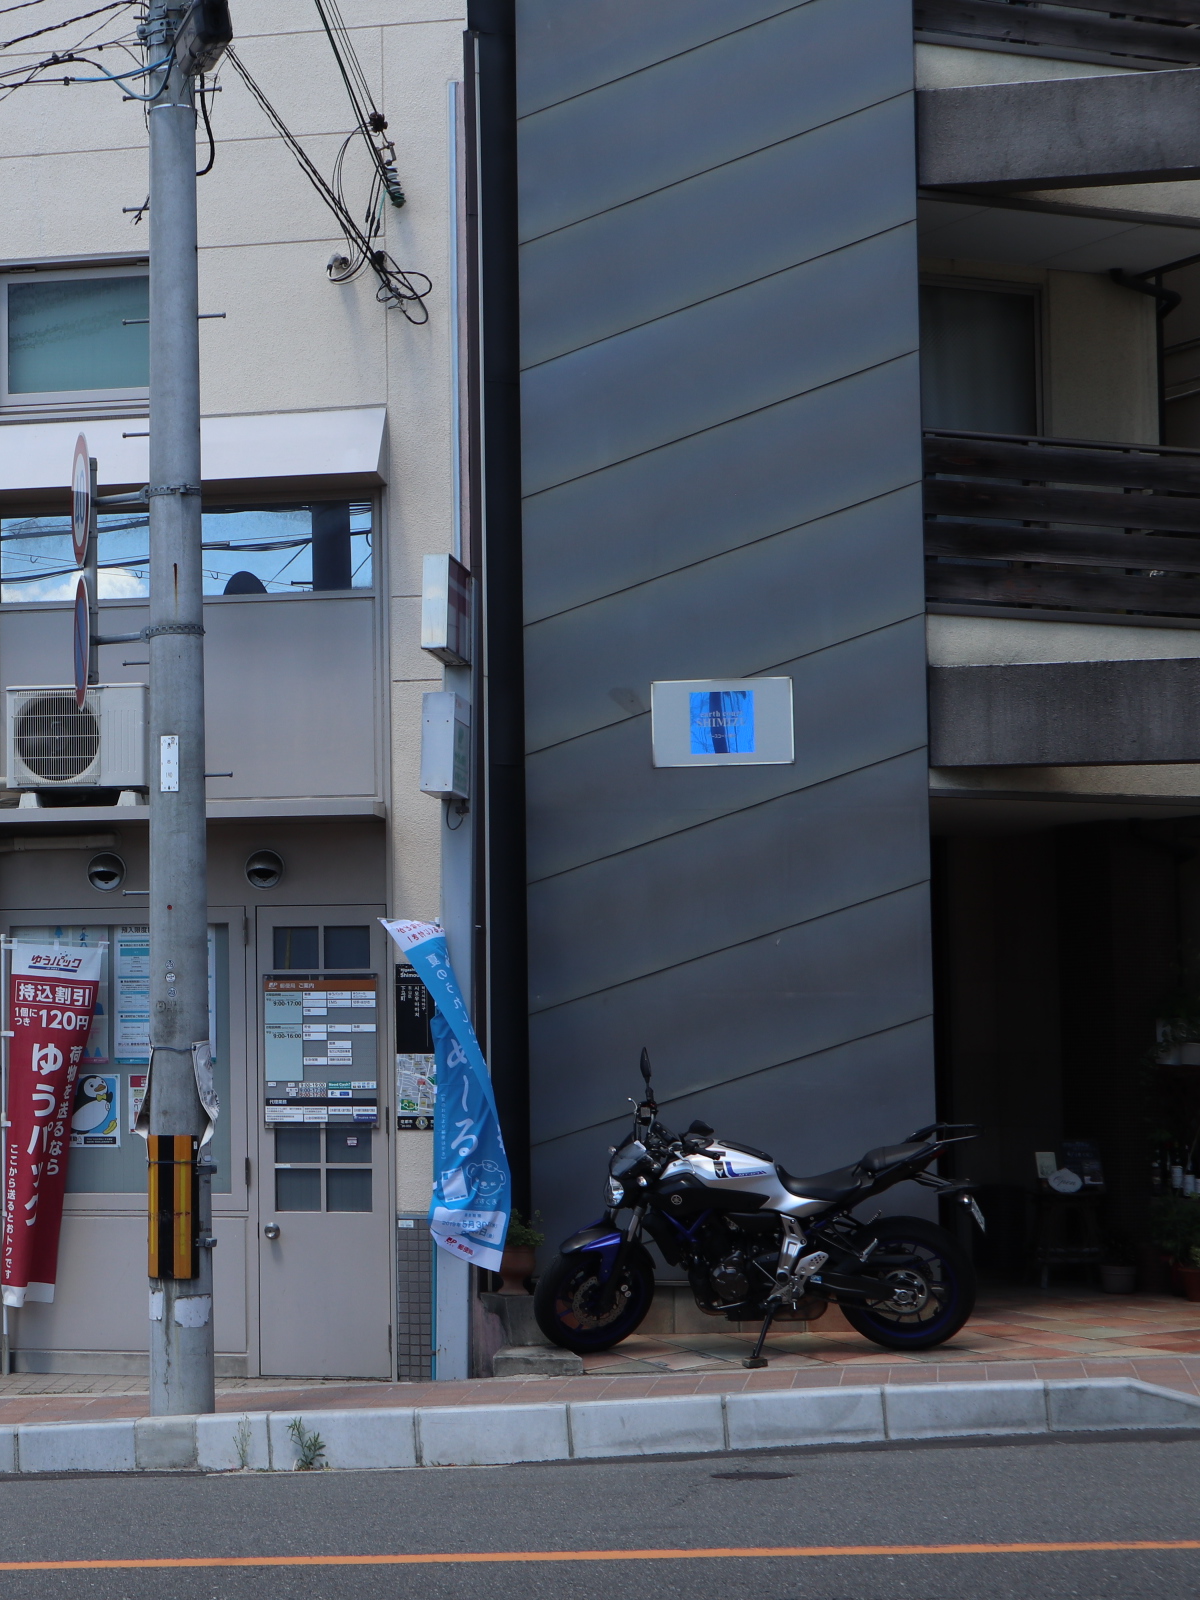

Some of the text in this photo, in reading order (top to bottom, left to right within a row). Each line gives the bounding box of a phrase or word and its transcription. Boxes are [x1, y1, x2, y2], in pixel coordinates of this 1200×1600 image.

[75, 470, 86, 530] 40
[121, 926, 149, 934] 預入限度
[31, 954, 82, 969] ゆうパック
[18, 983, 90, 1006] 持込割引
[39, 1009, 89, 1031] 120円
[47, 1045, 83, 1176] 荷物を送るなら
[24, 1043, 63, 1227] ゆうパック
[4, 1144, 18, 1279] ここから送るとおトクです
